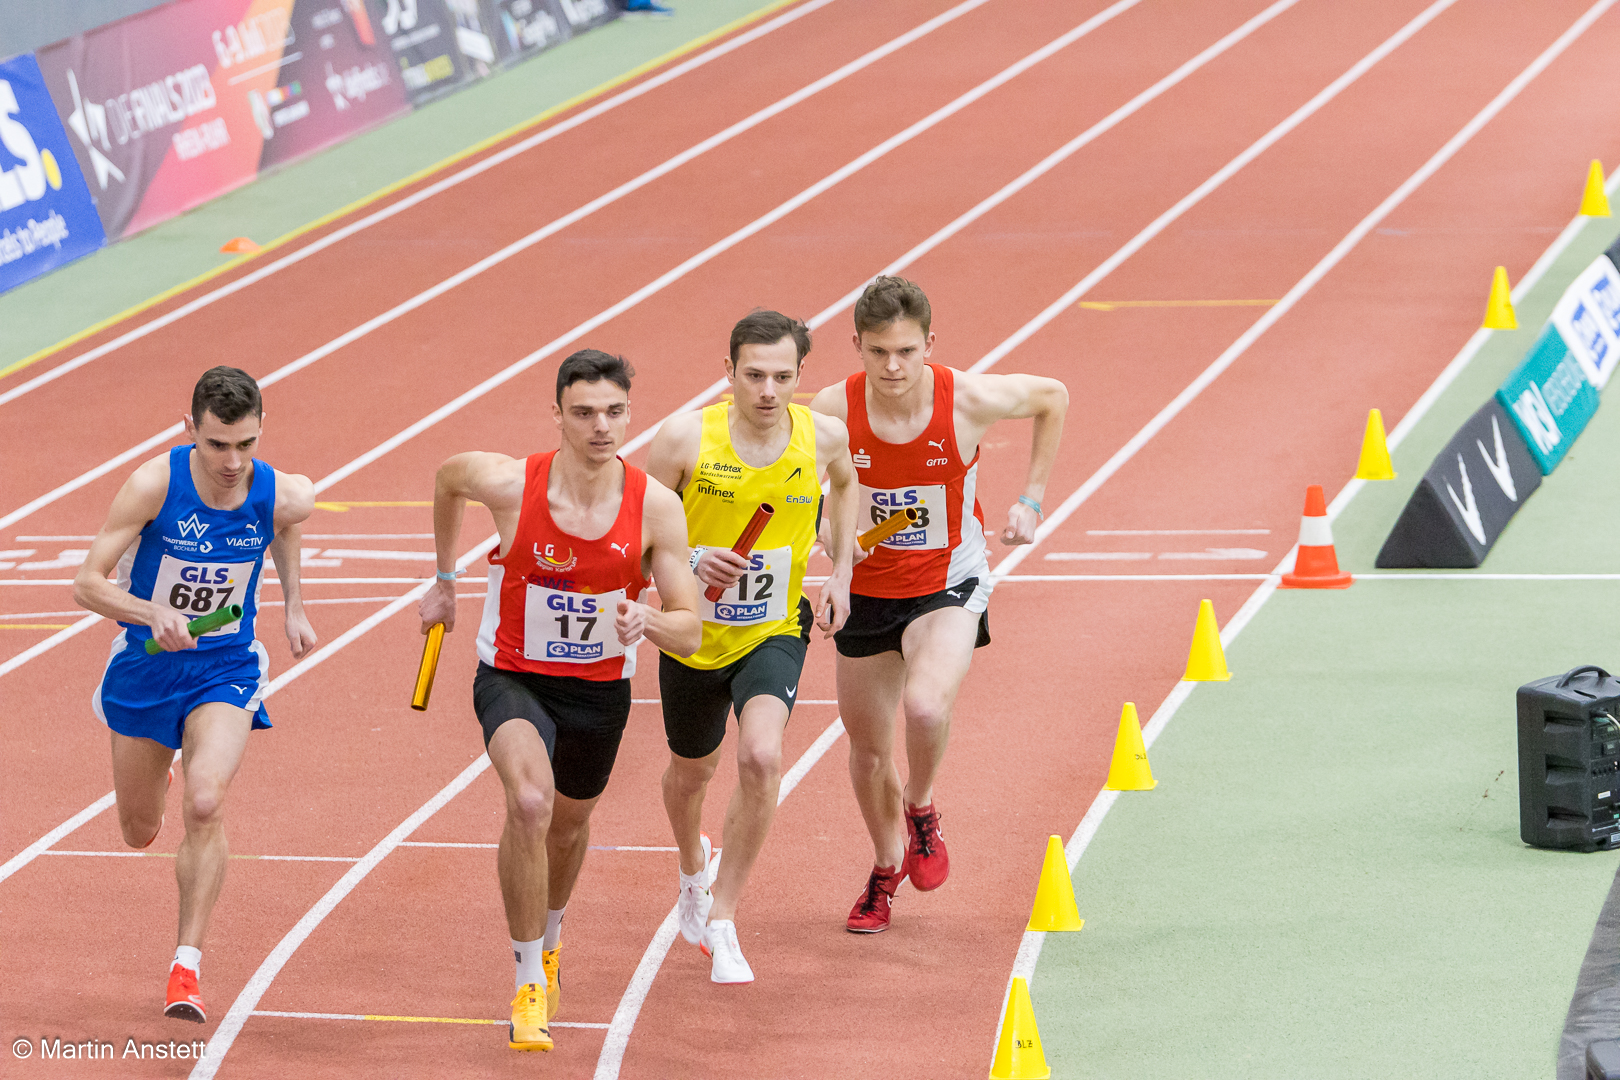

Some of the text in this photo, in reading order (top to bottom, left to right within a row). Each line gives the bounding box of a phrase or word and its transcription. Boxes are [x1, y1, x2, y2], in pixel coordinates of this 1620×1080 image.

[712, 462, 742, 473] farbtex
[697, 484, 735, 499] infinex
[786, 494, 812, 504] EnBW
[162, 535, 198, 547] STADTWERKE
[226, 536, 264, 547] VIACTIV
[895, 533, 925, 542] PLAN
[169, 583, 236, 612] 687
[736, 605, 766, 616] PLAN
[554, 613, 598, 641] 17
[570, 645, 601, 654] PLAN
